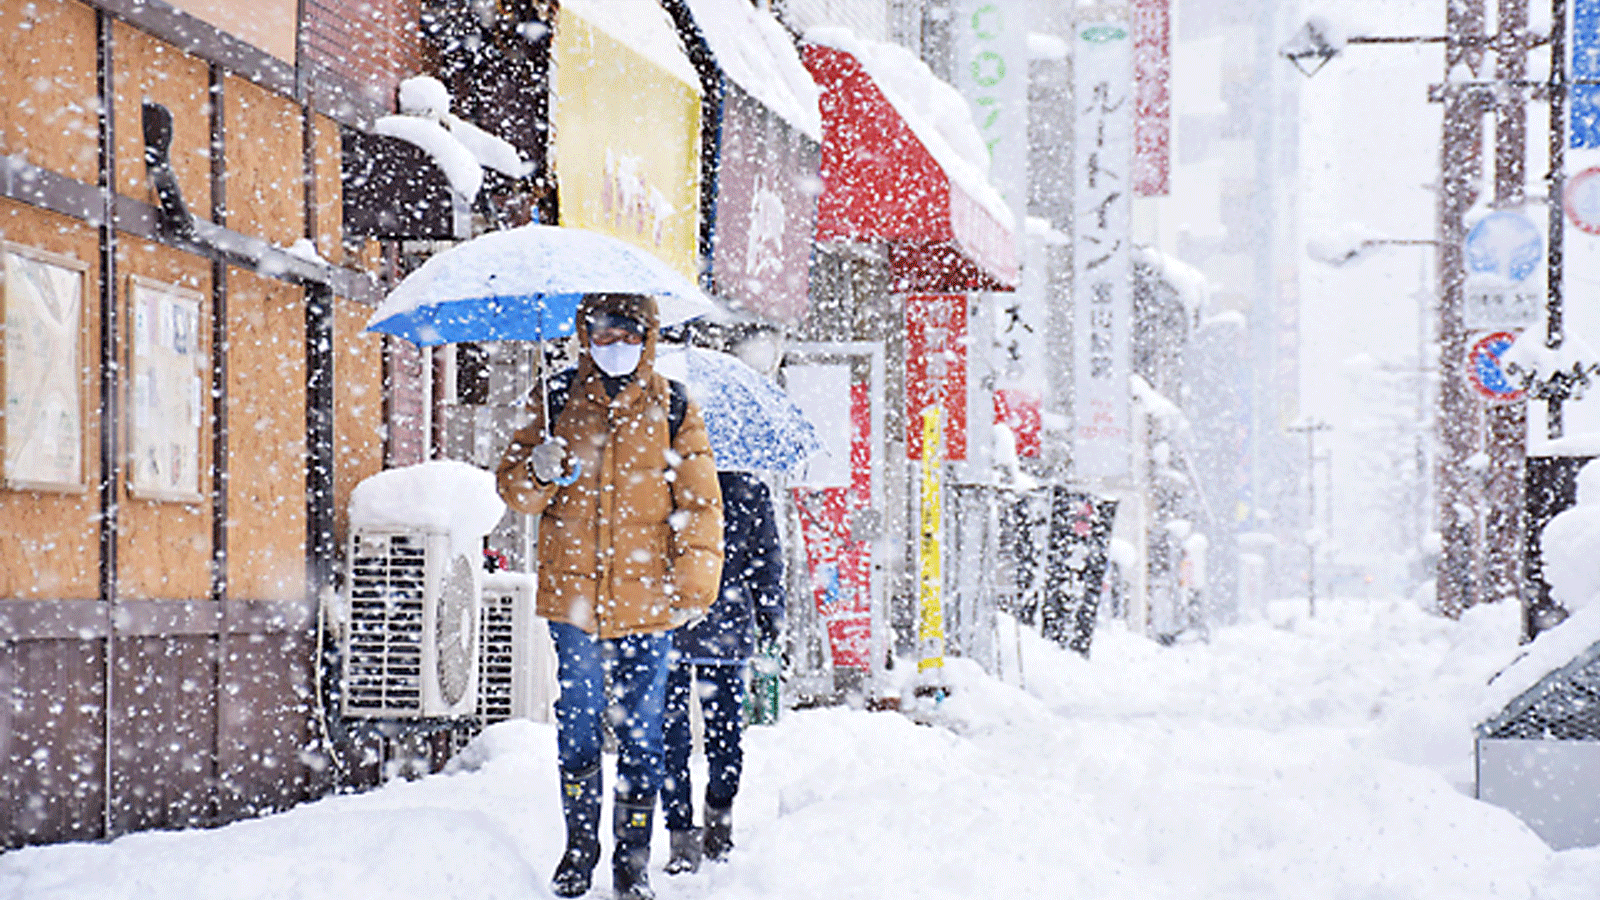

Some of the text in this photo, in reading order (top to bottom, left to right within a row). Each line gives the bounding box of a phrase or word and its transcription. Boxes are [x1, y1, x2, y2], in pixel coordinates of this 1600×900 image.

[1078, 82, 1126, 270] ルートイン
